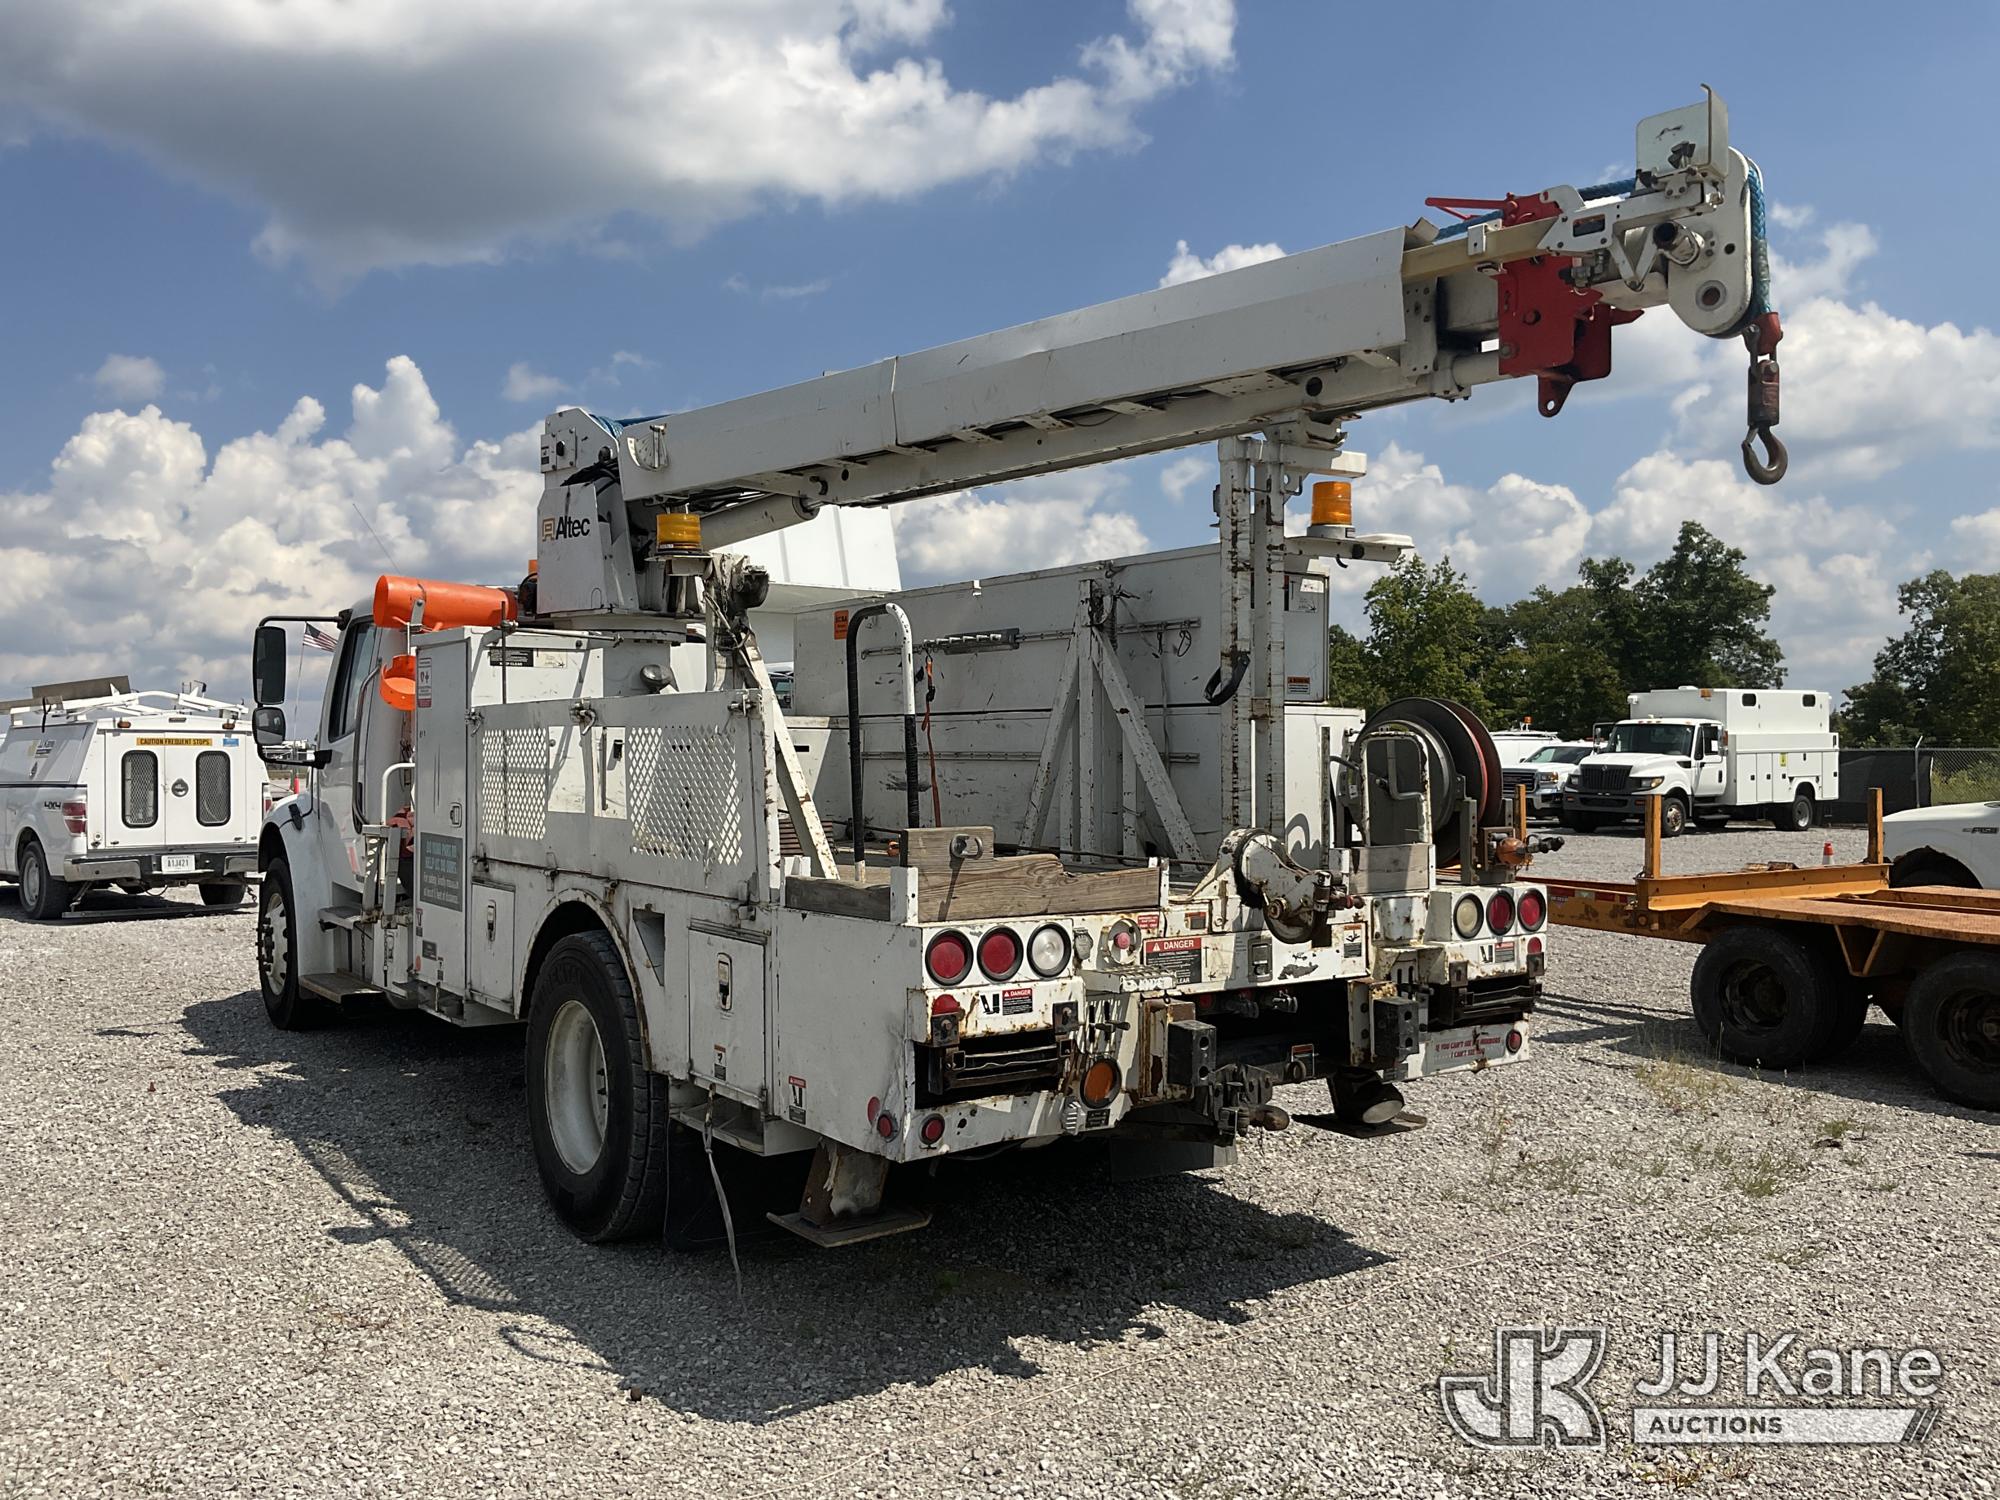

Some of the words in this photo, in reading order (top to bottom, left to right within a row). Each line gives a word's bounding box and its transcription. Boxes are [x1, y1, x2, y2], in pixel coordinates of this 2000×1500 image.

[556, 516, 590, 540] Altec
[1163, 939, 1194, 950] DANGER
[1010, 989, 1031, 997] DANGER
